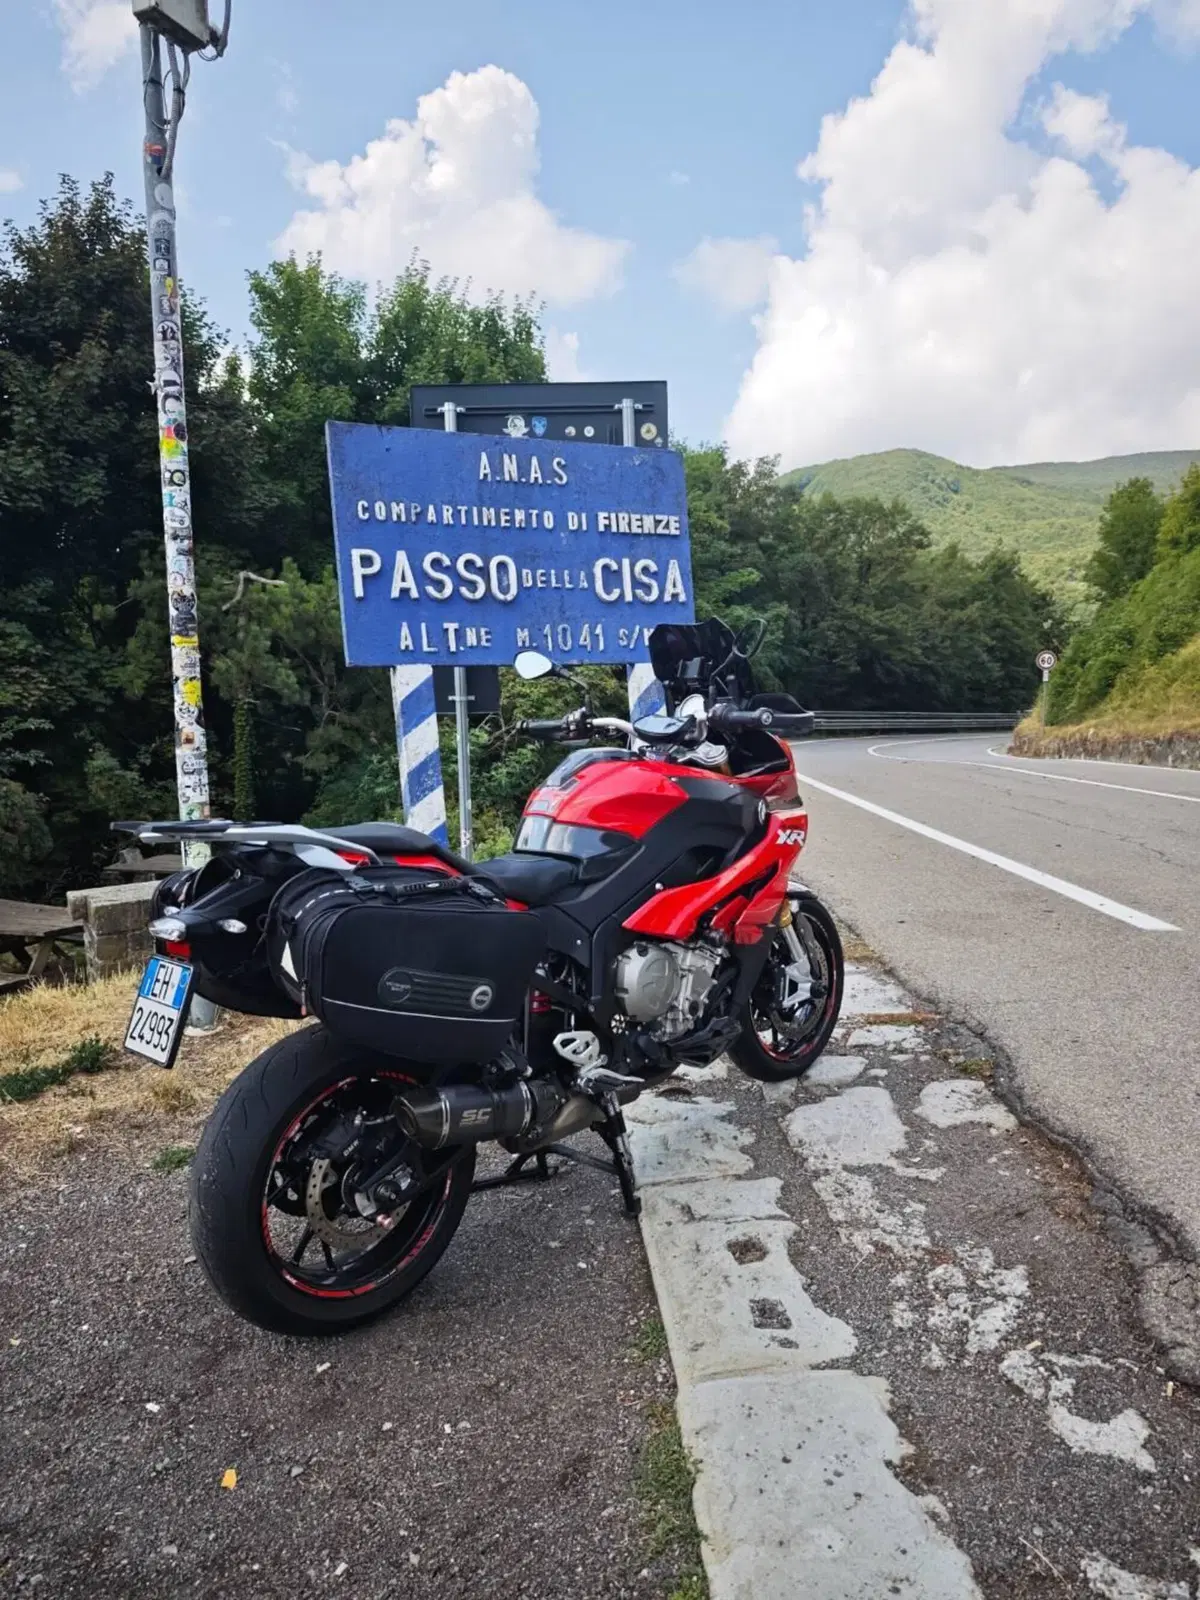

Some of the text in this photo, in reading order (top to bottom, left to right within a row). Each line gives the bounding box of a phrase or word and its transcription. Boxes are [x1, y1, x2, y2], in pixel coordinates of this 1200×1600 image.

[479, 452, 568, 485] A.N.A.S
[357, 500, 681, 536] COMPARTIMENTO DI FIRENZE
[351, 549, 687, 604] PASSO DELLA CISA
[1040, 655, 1054, 666] 60
[775, 829, 805, 847] XR
[151, 964, 174, 1000] EH
[129, 1007, 174, 1052] 24993
[460, 1107, 493, 1121] SC
